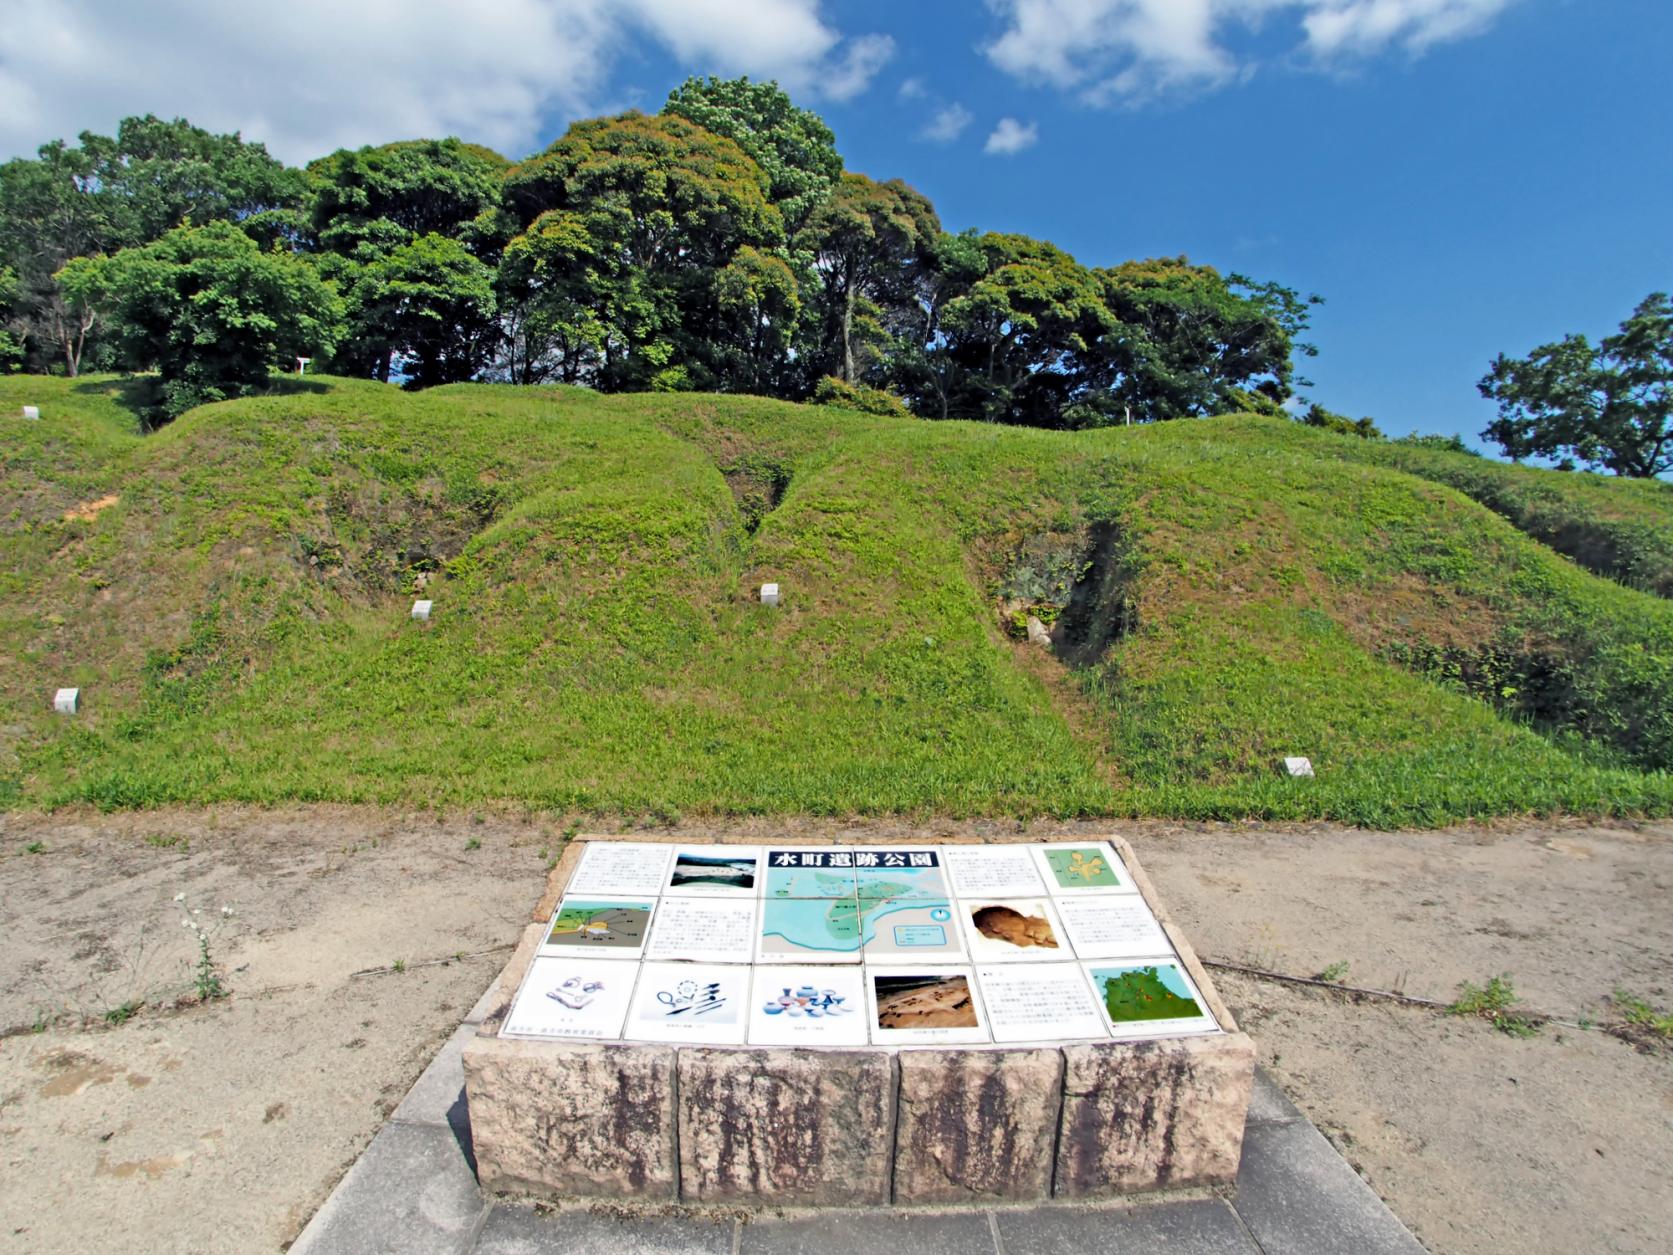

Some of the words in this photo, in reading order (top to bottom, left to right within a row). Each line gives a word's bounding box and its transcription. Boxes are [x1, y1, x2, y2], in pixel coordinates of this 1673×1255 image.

[774, 852, 932, 867] 水町遺跡公園
